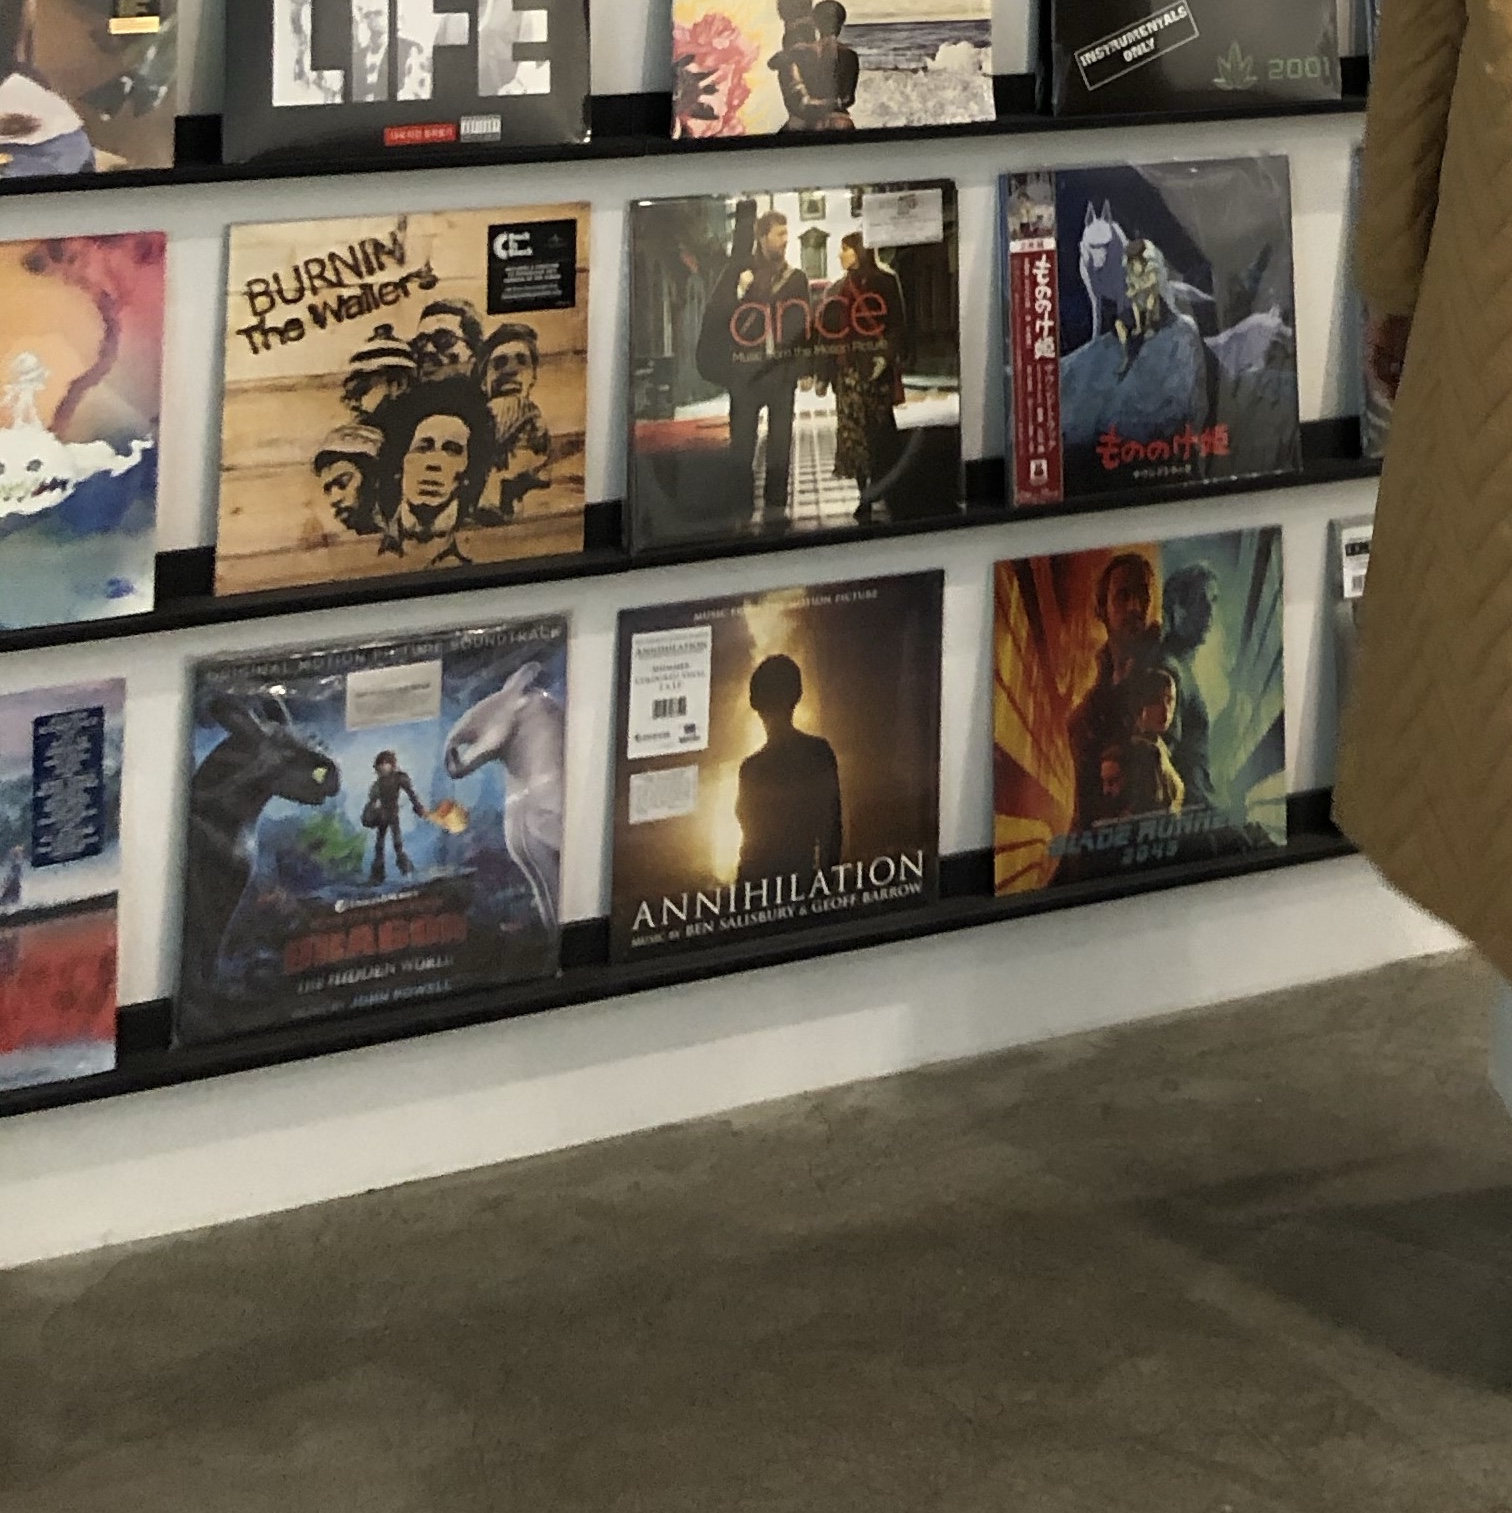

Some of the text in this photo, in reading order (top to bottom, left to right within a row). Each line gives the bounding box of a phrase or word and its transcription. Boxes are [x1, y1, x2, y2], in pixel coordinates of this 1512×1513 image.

[1079, 5, 1188, 68] INSTRUMENTALS
[1123, 37, 1156, 63] ONLY
[1267, 56, 1331, 80] 2001
[236, 314, 306, 354] The
[631, 850, 924, 931] ANNIHILATION
[686, 920, 714, 937] BEN
[719, 902, 794, 930] SALISBURY
[862, 880, 923, 905] BARROW
